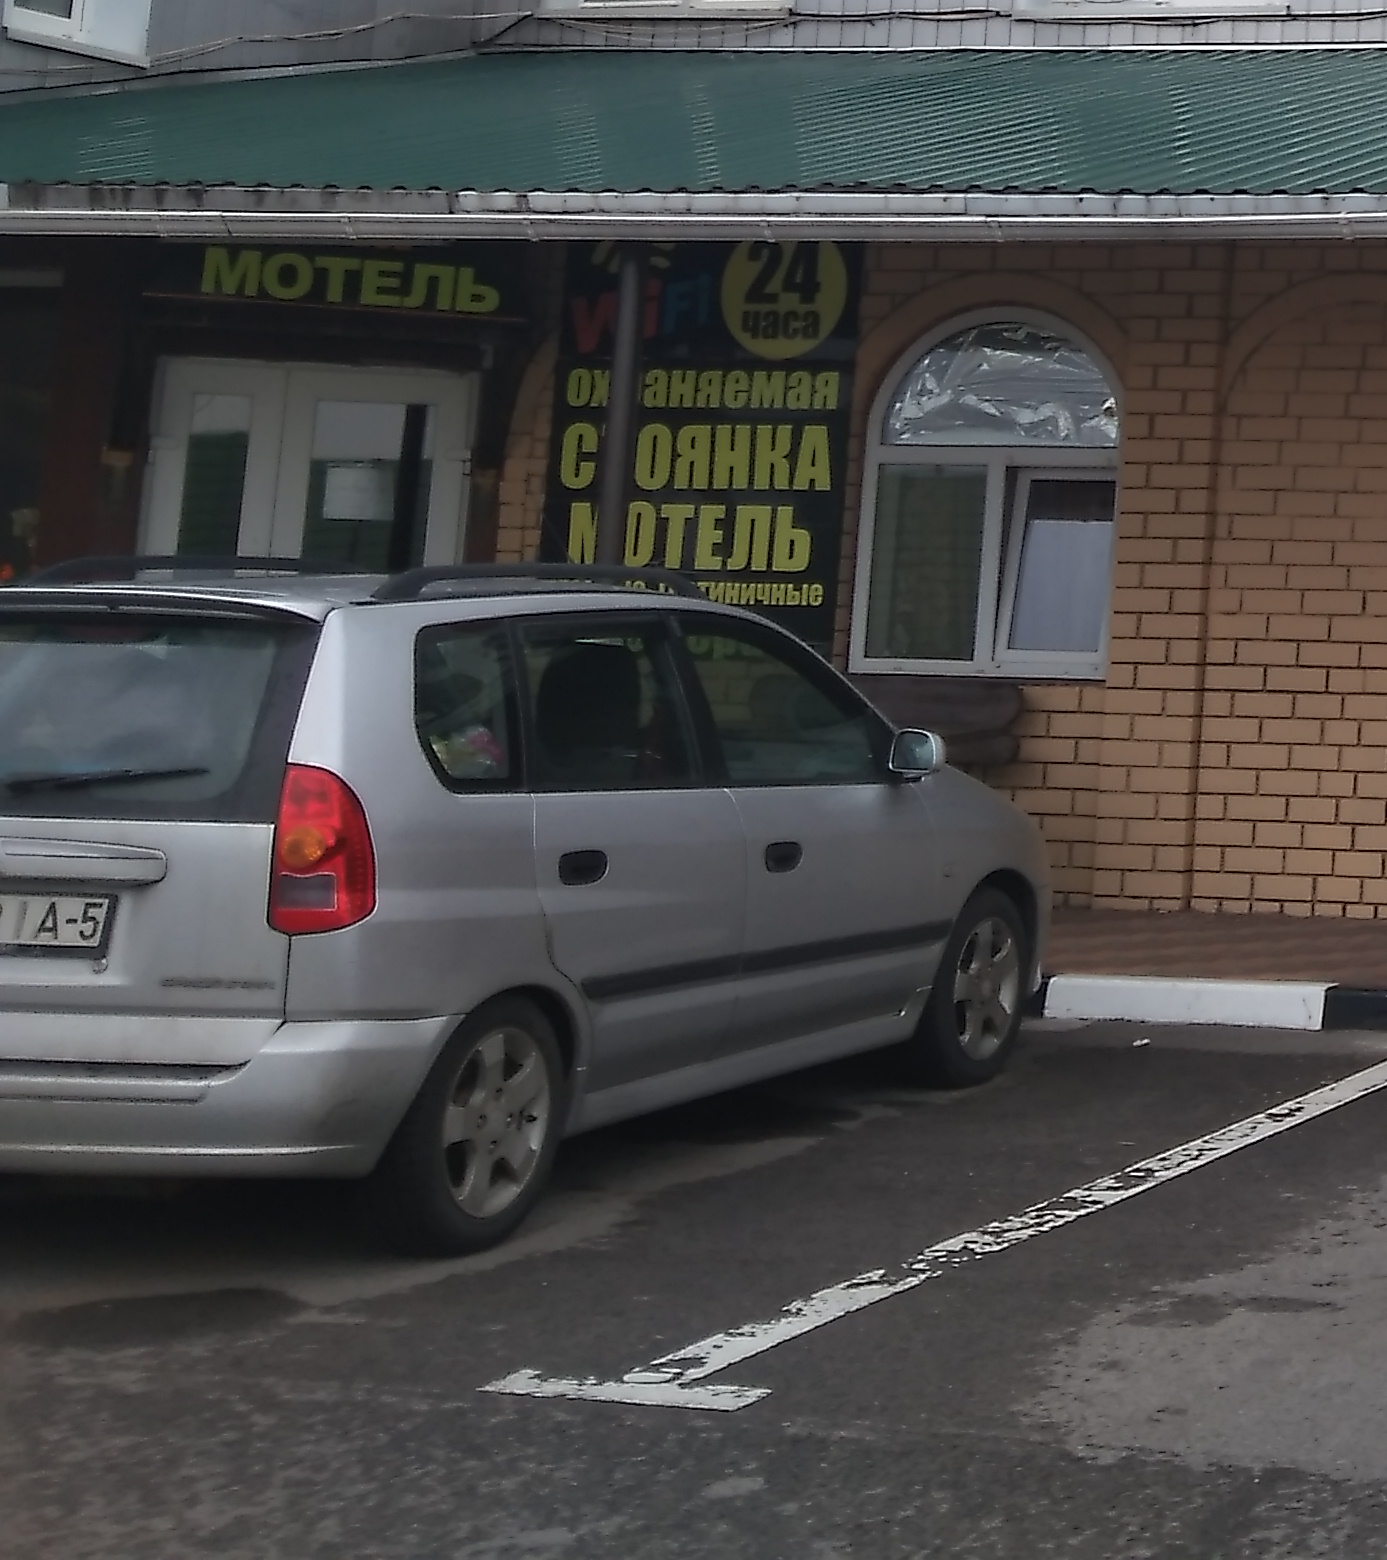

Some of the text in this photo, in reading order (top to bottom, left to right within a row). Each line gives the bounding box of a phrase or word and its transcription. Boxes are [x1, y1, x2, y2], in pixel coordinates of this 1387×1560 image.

[201, 246, 500, 314] МОТЕЛЬ
[744, 241, 821, 305] 24
[741, 309, 821, 340] часа
[567, 368, 840, 411] оханяемая
[560, 422, 832, 491] СОЯНКА
